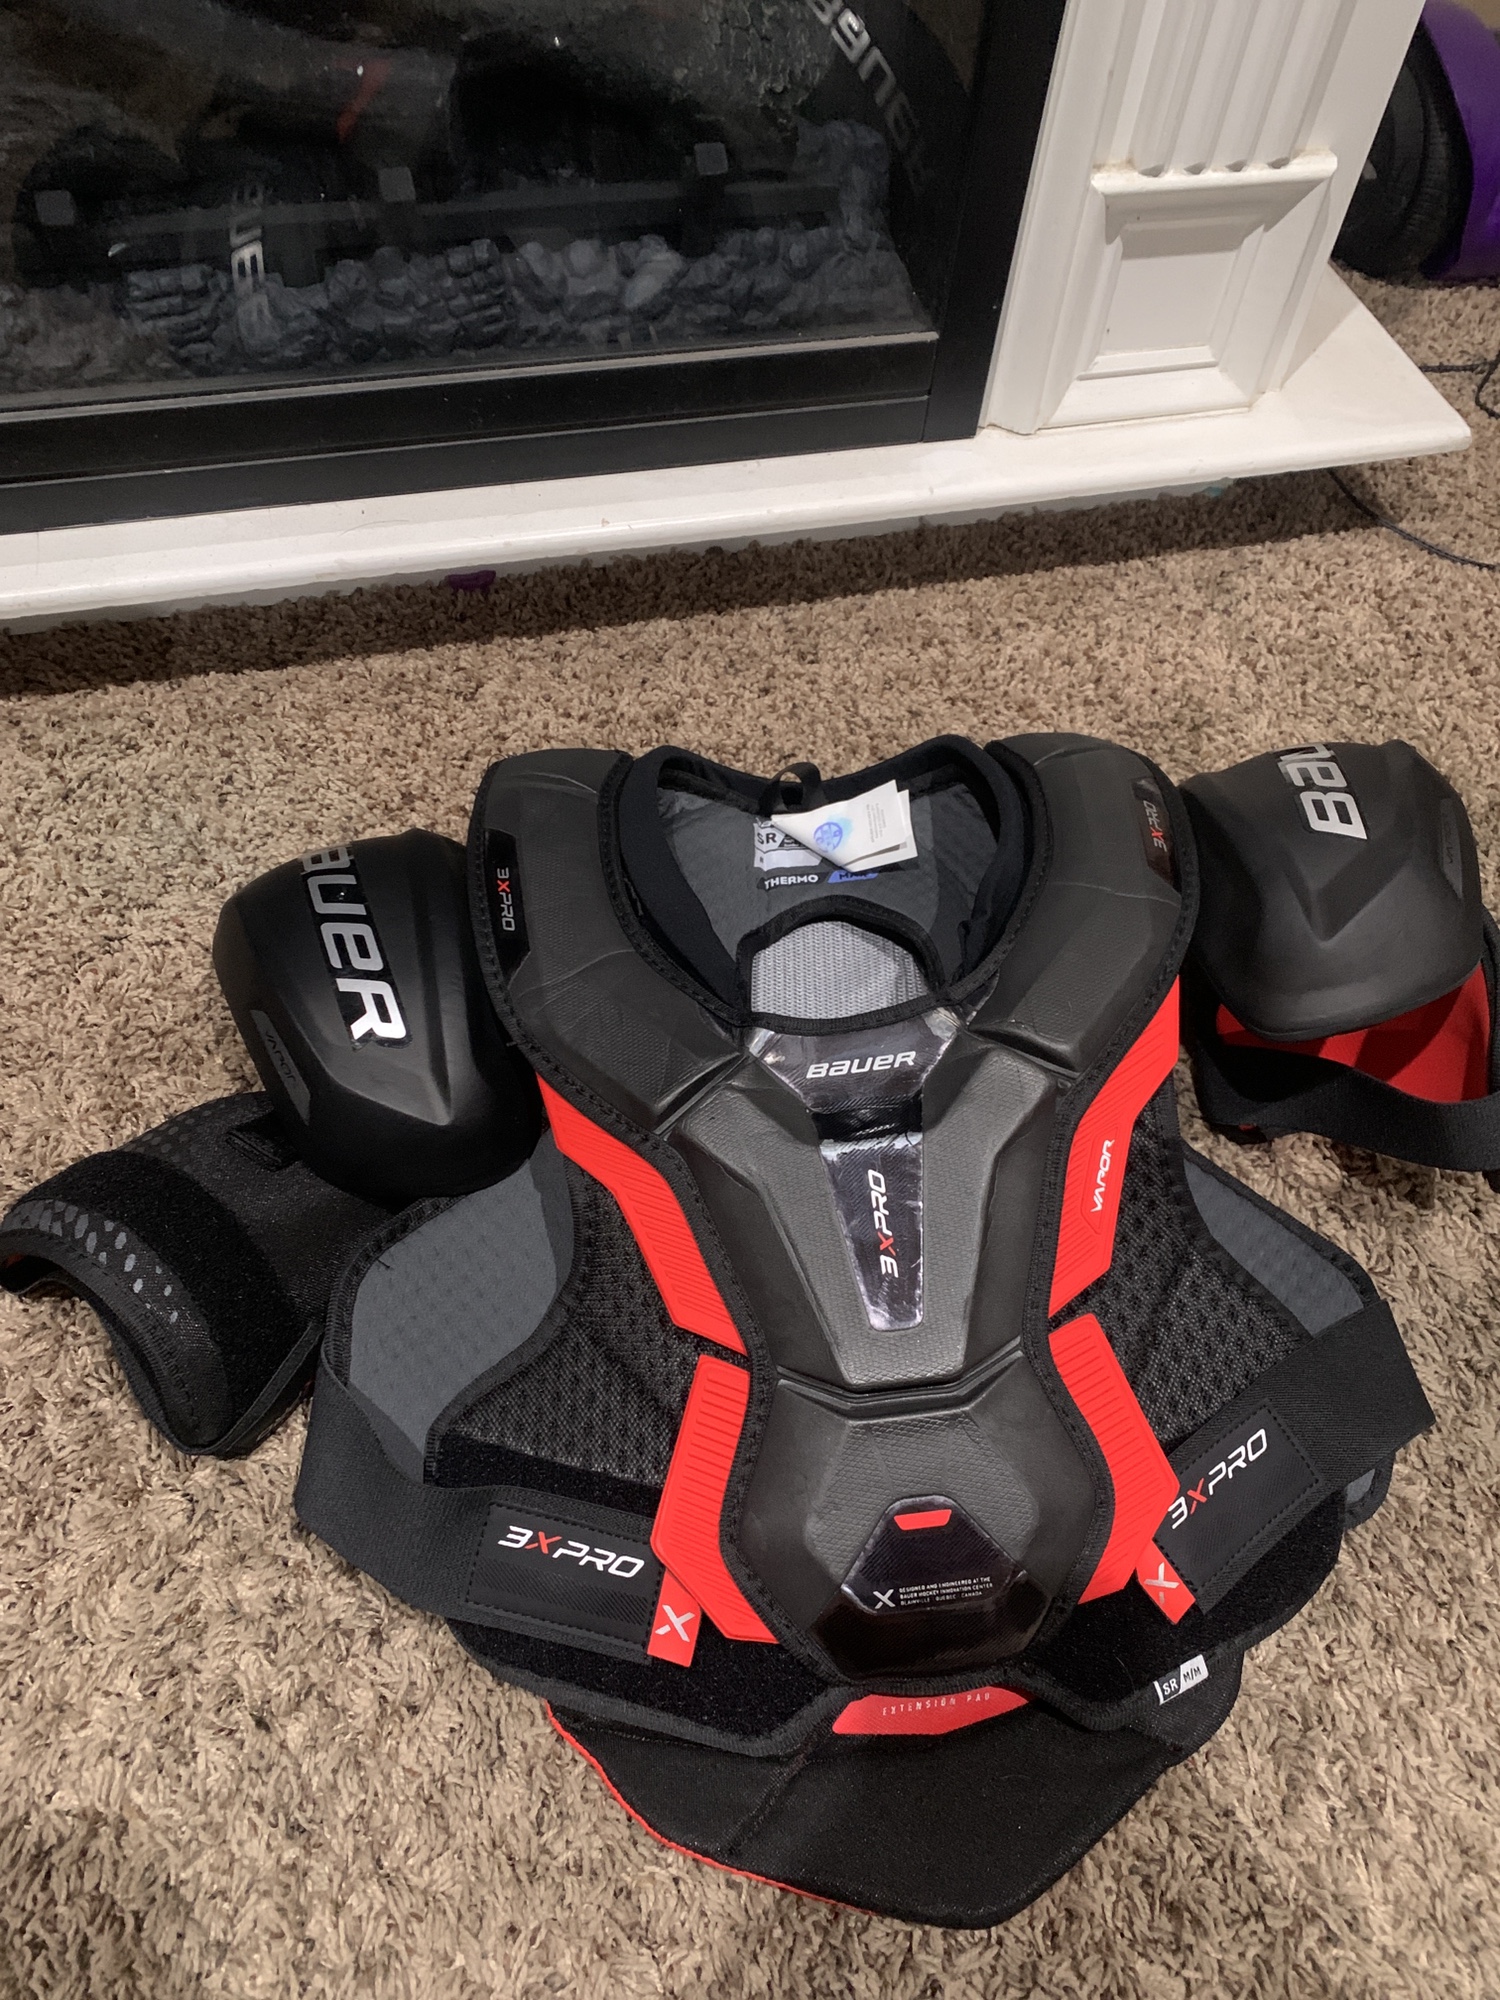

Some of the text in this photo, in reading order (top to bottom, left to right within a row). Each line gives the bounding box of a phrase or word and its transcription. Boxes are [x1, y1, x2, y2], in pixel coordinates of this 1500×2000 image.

[756, 832, 777, 845] SR
[764, 874, 820, 890] THERMO
[496, 866, 517, 932] 3XPRO
[1091, 1139, 1114, 1213] VAPOR
[867, 1169, 899, 1278] 3XPRO
[1166, 1428, 1269, 1530] 3XPRO
[497, 1525, 645, 1579] 3XPRO
[899, 1582, 993, 1600] BAUER HOCKEY INNOVATION CENTER
[980, 1575, 991, 1583] THE
[961, 1590, 983, 1598] CANADA
[1162, 1665, 1202, 1695] SR M/M
[882, 1697, 956, 1716] EXTENSION
